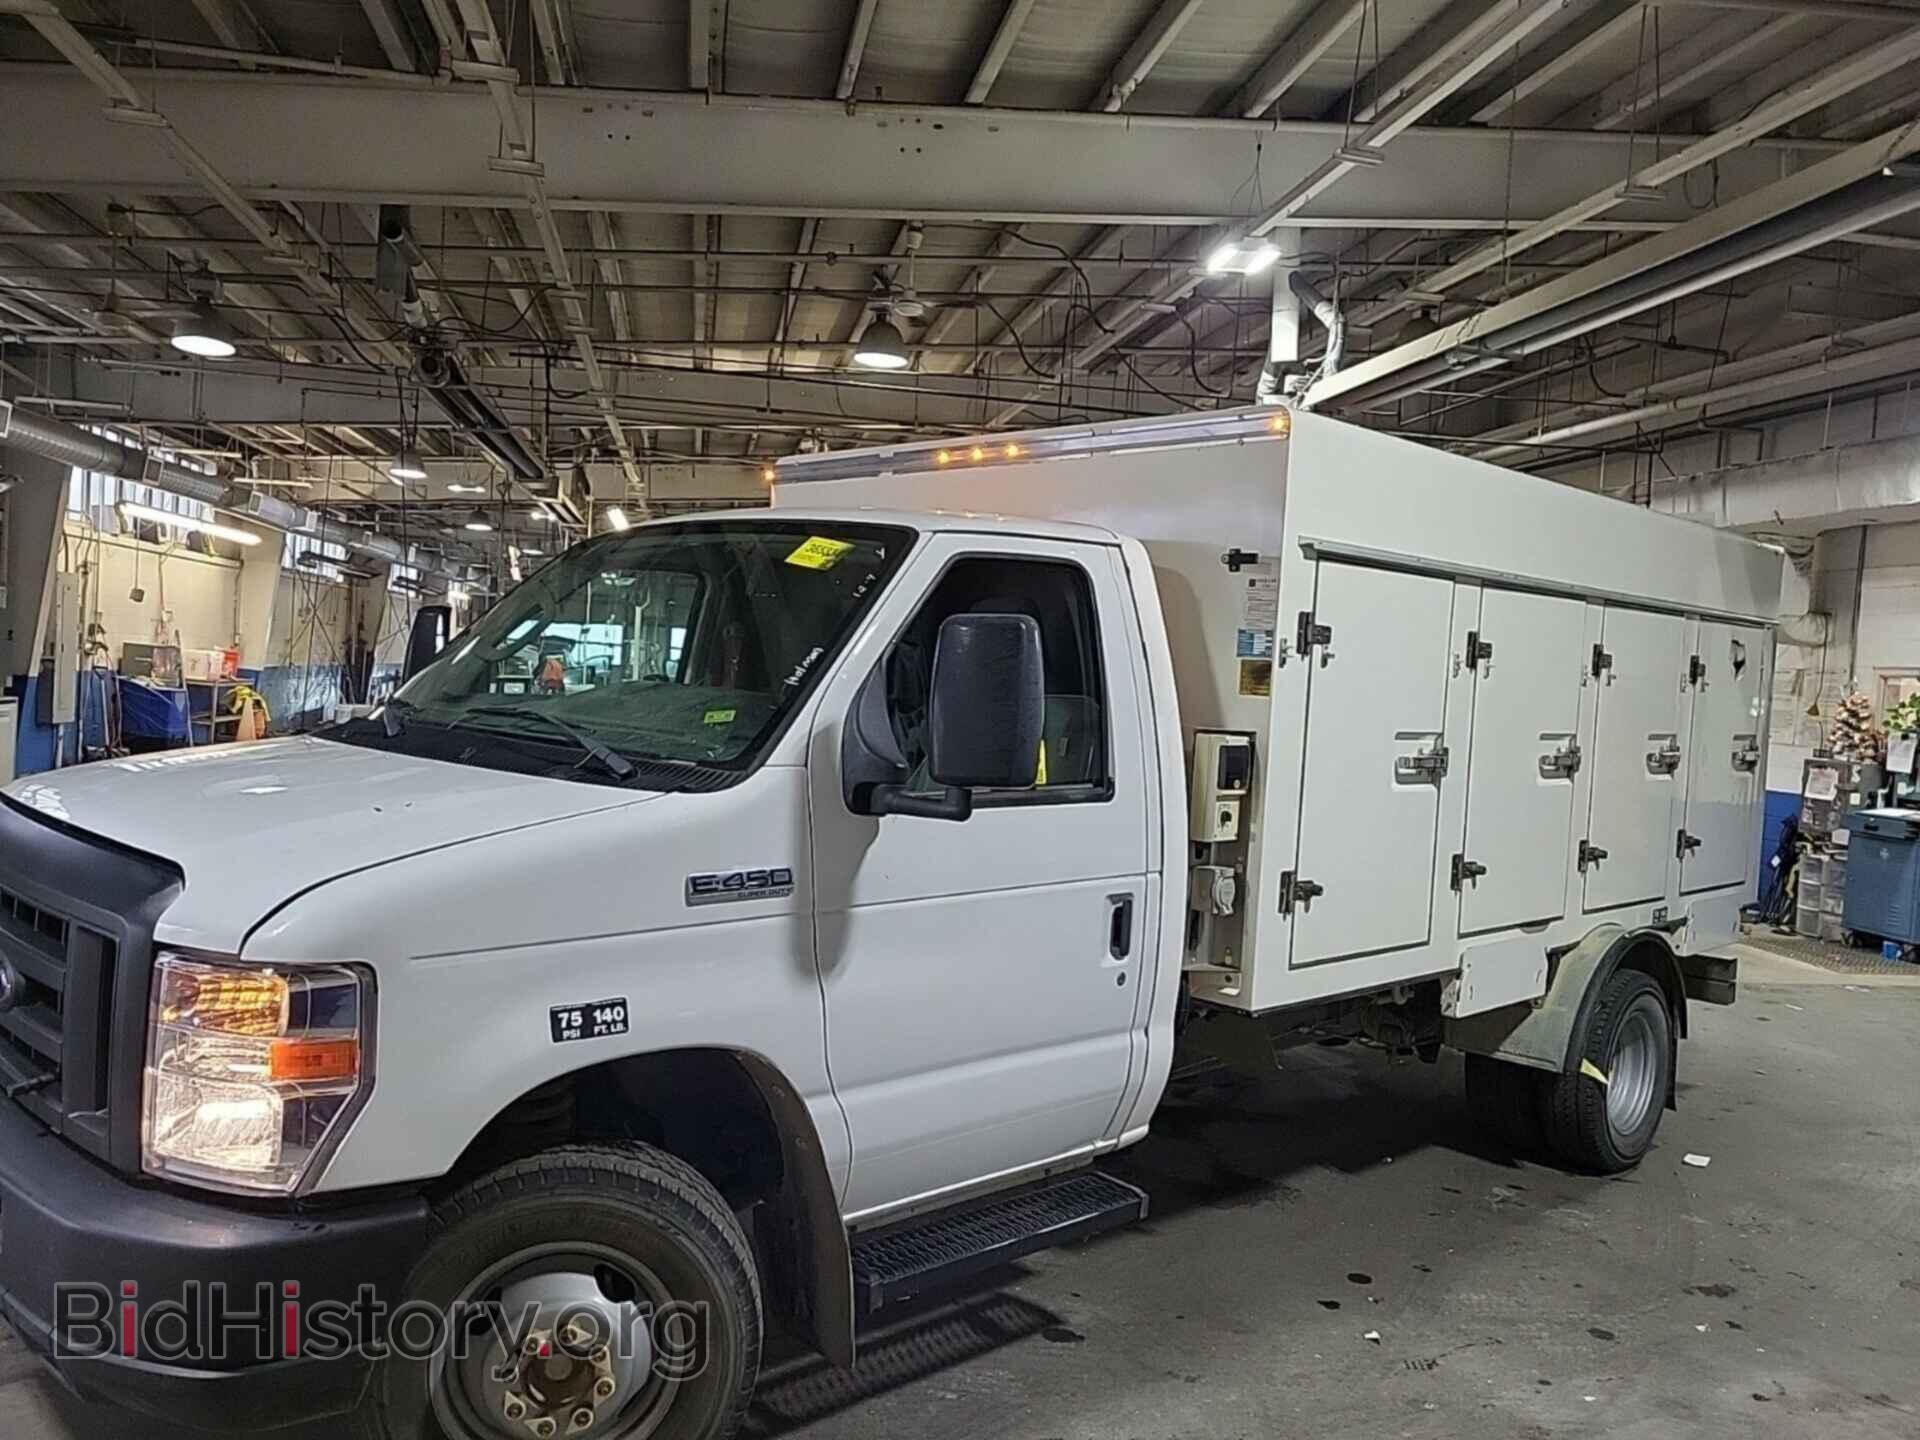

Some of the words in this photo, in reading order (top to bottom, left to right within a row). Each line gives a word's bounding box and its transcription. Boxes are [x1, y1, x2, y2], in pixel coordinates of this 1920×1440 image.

[557, 1010, 583, 1028] 75
[592, 1005, 625, 1024] 140
[562, 1028, 581, 1040] PSI
